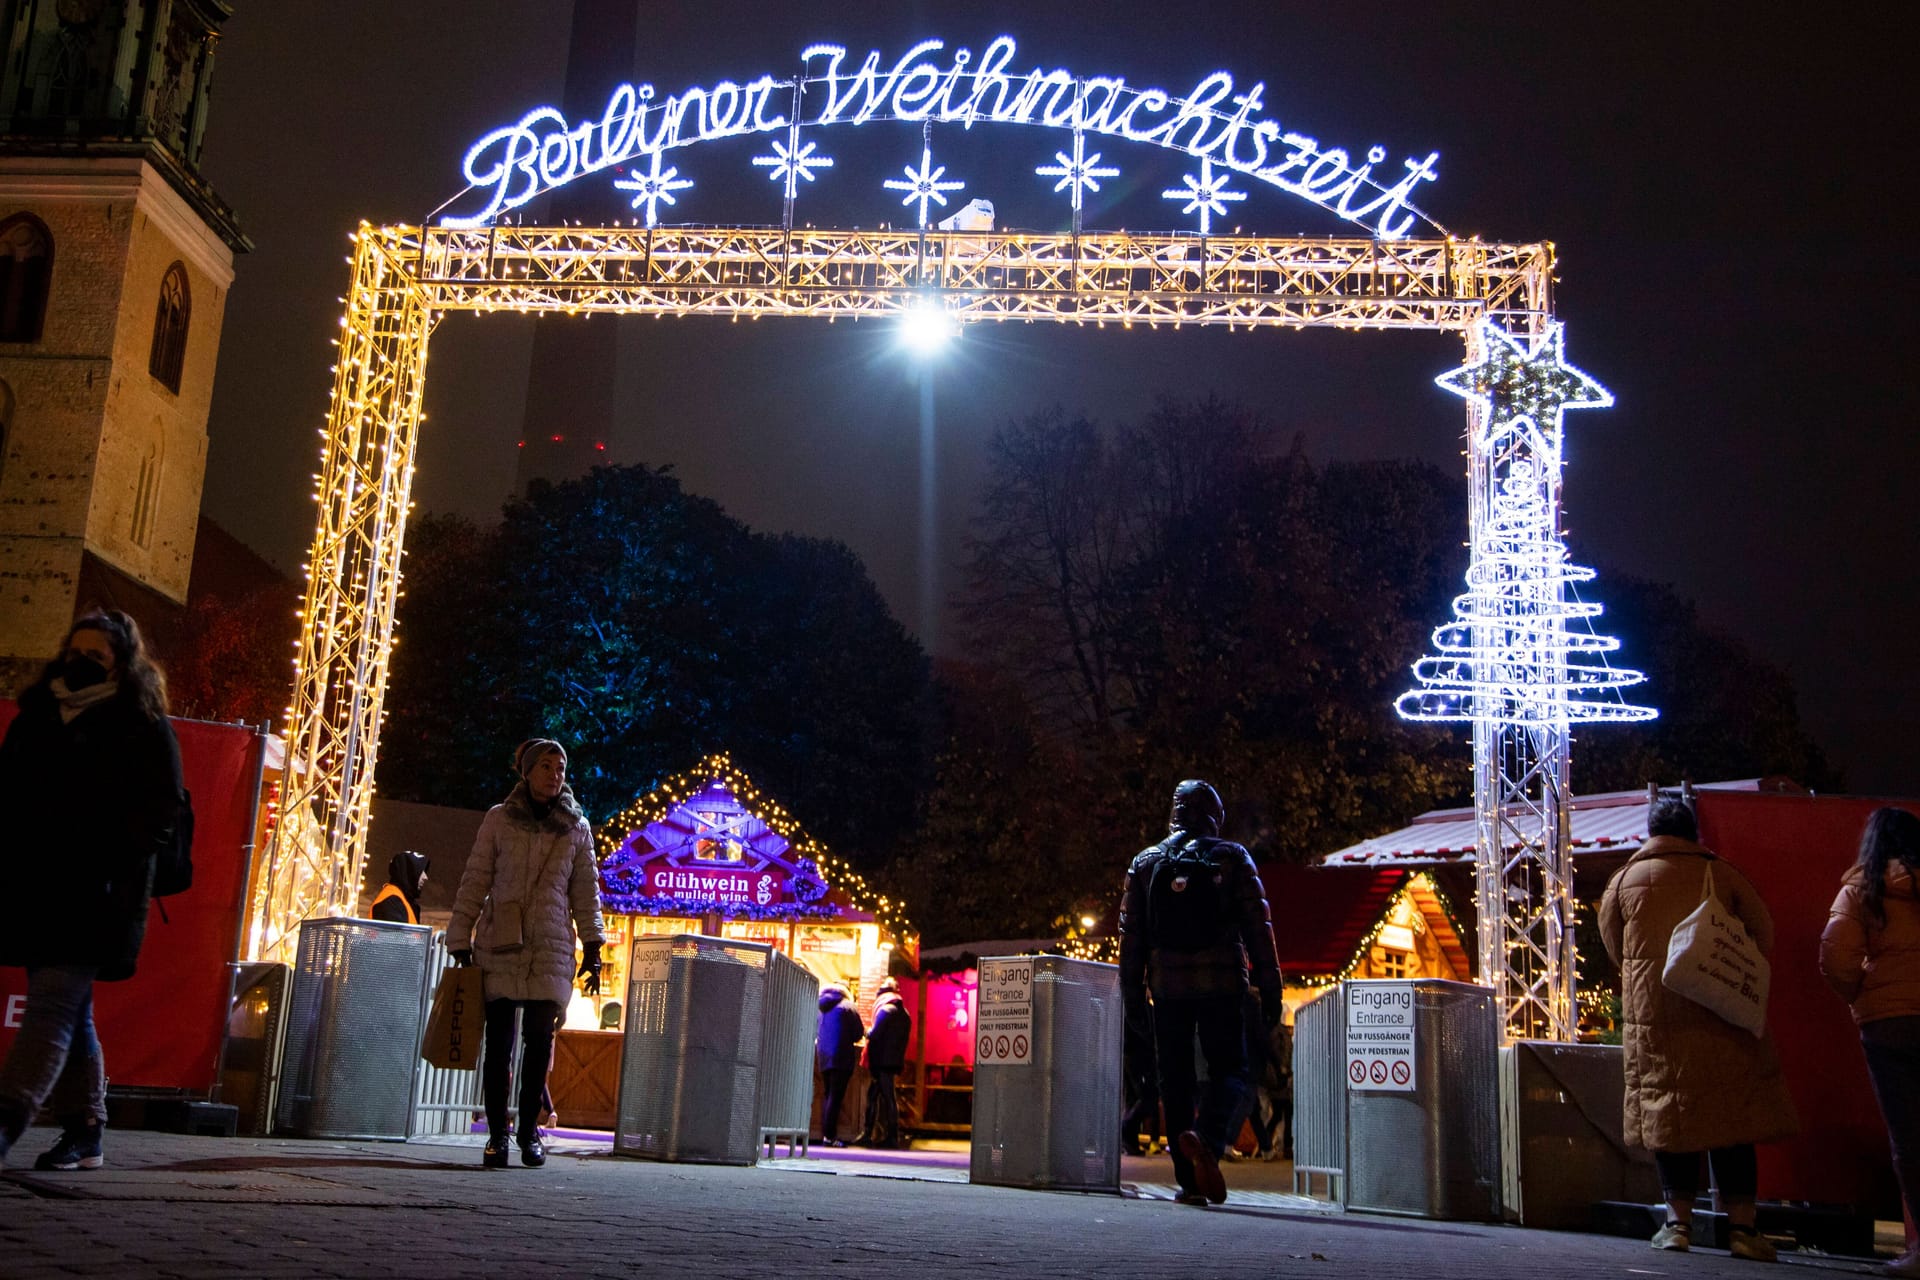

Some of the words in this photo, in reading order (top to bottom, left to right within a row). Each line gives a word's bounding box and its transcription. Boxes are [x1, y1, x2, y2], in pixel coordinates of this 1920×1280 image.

[438, 73, 785, 229] Berliner
[801, 35, 1440, 241] Weihnachtszeit
[654, 871, 749, 892] Glühwein
[674, 890, 716, 901] mulled
[719, 891, 749, 903] wine
[635, 947, 670, 966] Ausgang
[643, 967, 656, 979] Exit
[982, 966, 1030, 986] Eingang
[986, 988, 1024, 1001] Entrance
[1351, 988, 1411, 1010] Eingang
[980, 1008, 992, 1017] NUR
[993, 1007, 1029, 1017] FUSSGÄNGER
[1356, 1011, 1405, 1024] Entrance
[448, 984, 465, 1062] DEPOT
[980, 1023, 994, 1031] ONLY
[995, 1022, 1029, 1031] PEDESTRIAN
[1348, 1032, 1362, 1041] NUR
[1364, 1031, 1411, 1041] FUSSGÄNGER
[1349, 1047, 1367, 1055] ONLY
[1368, 1047, 1410, 1056] PEDESTRIAN
